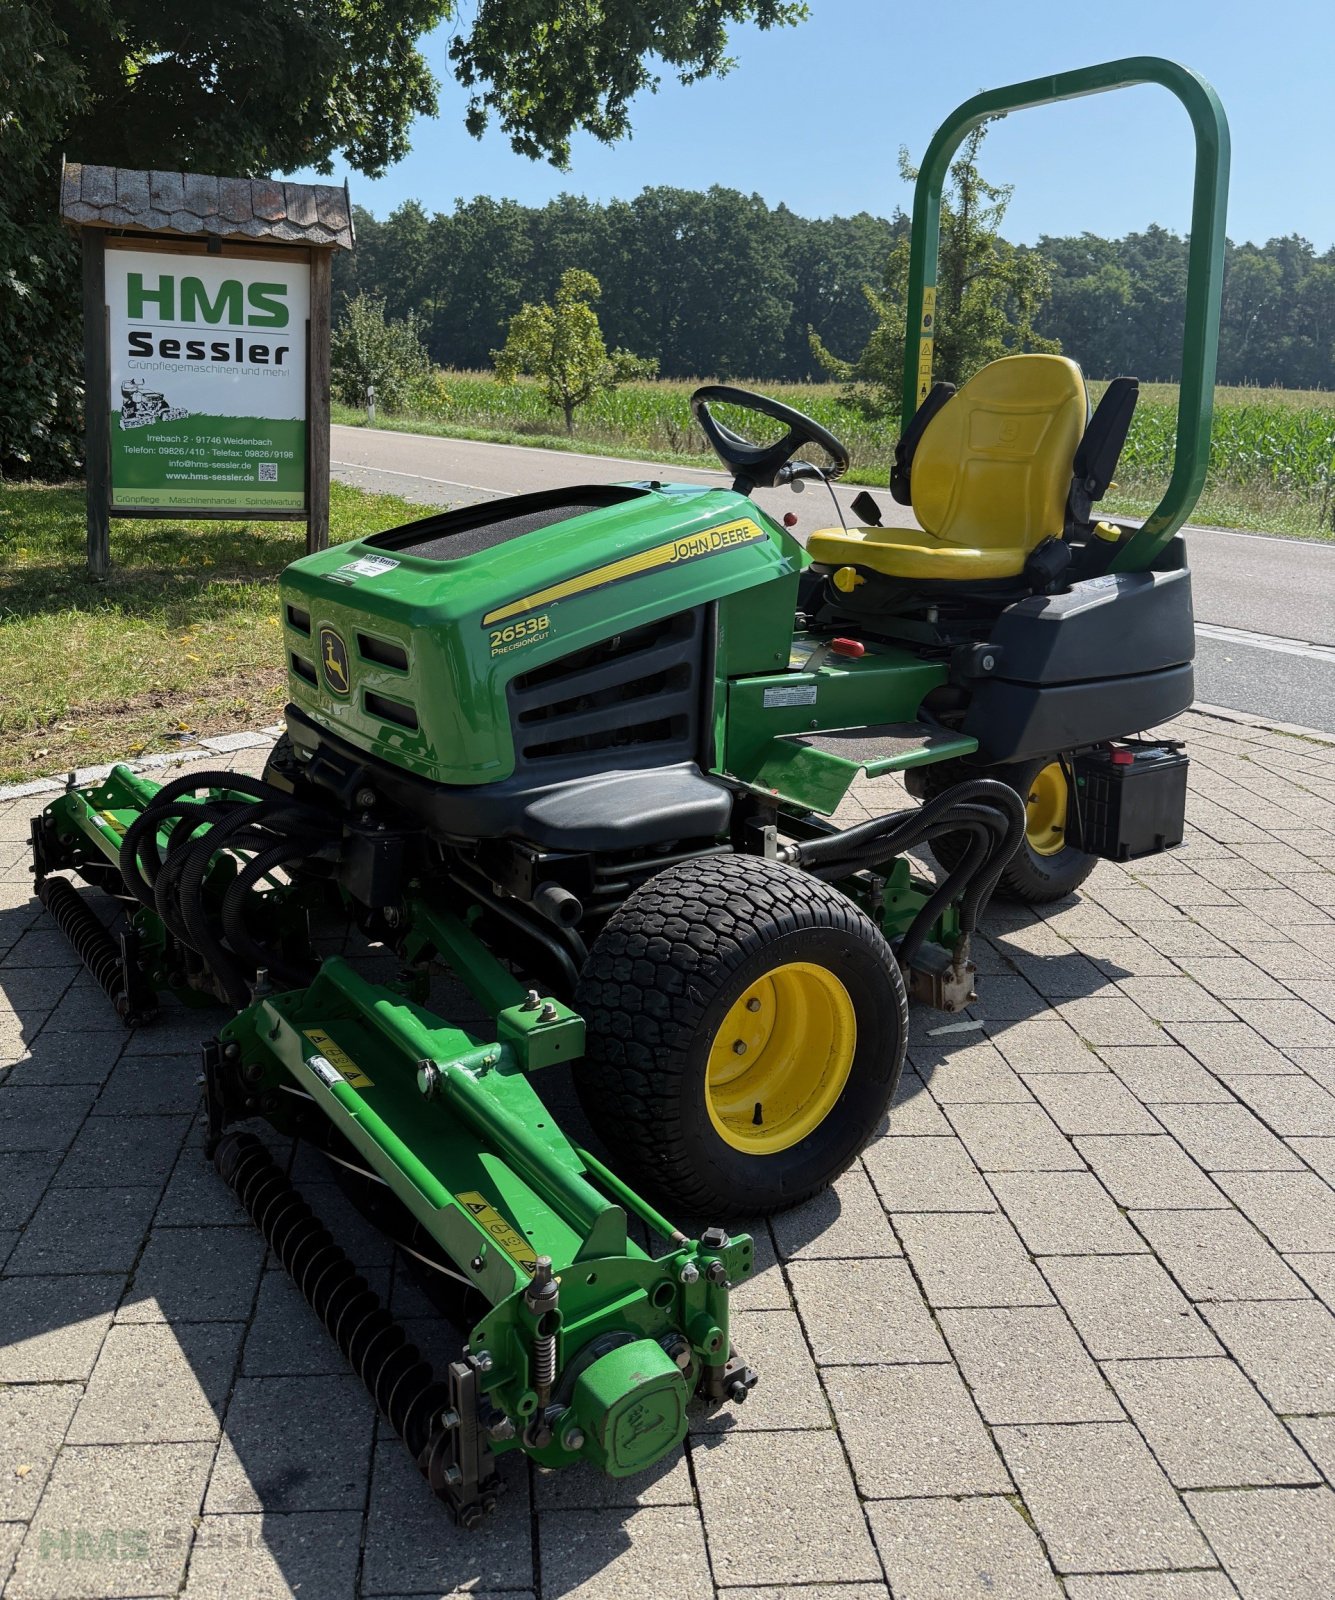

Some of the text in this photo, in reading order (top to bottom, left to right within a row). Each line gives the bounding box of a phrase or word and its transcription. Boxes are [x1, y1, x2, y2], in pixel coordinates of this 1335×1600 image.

[127, 272, 289, 328] HMS
[128, 331, 290, 365] Sessler
[127, 360, 290, 377] Grünpflegemaschinen und mehr!
[147, 434, 272, 446] Irrebach 2 91746 Weidenbach
[123, 445, 156, 454] Telefon:
[212, 449, 243, 457] Telefax:
[168, 460, 252, 470] info@hms-sessler.de
[165, 472, 255, 482] www.hms-sessler.de
[115, 495, 302, 507] Grünpflege Maschinenhandel Spindelwartung
[669, 526, 752, 562] JOHN DEERE
[489, 614, 551, 648] 2653B
